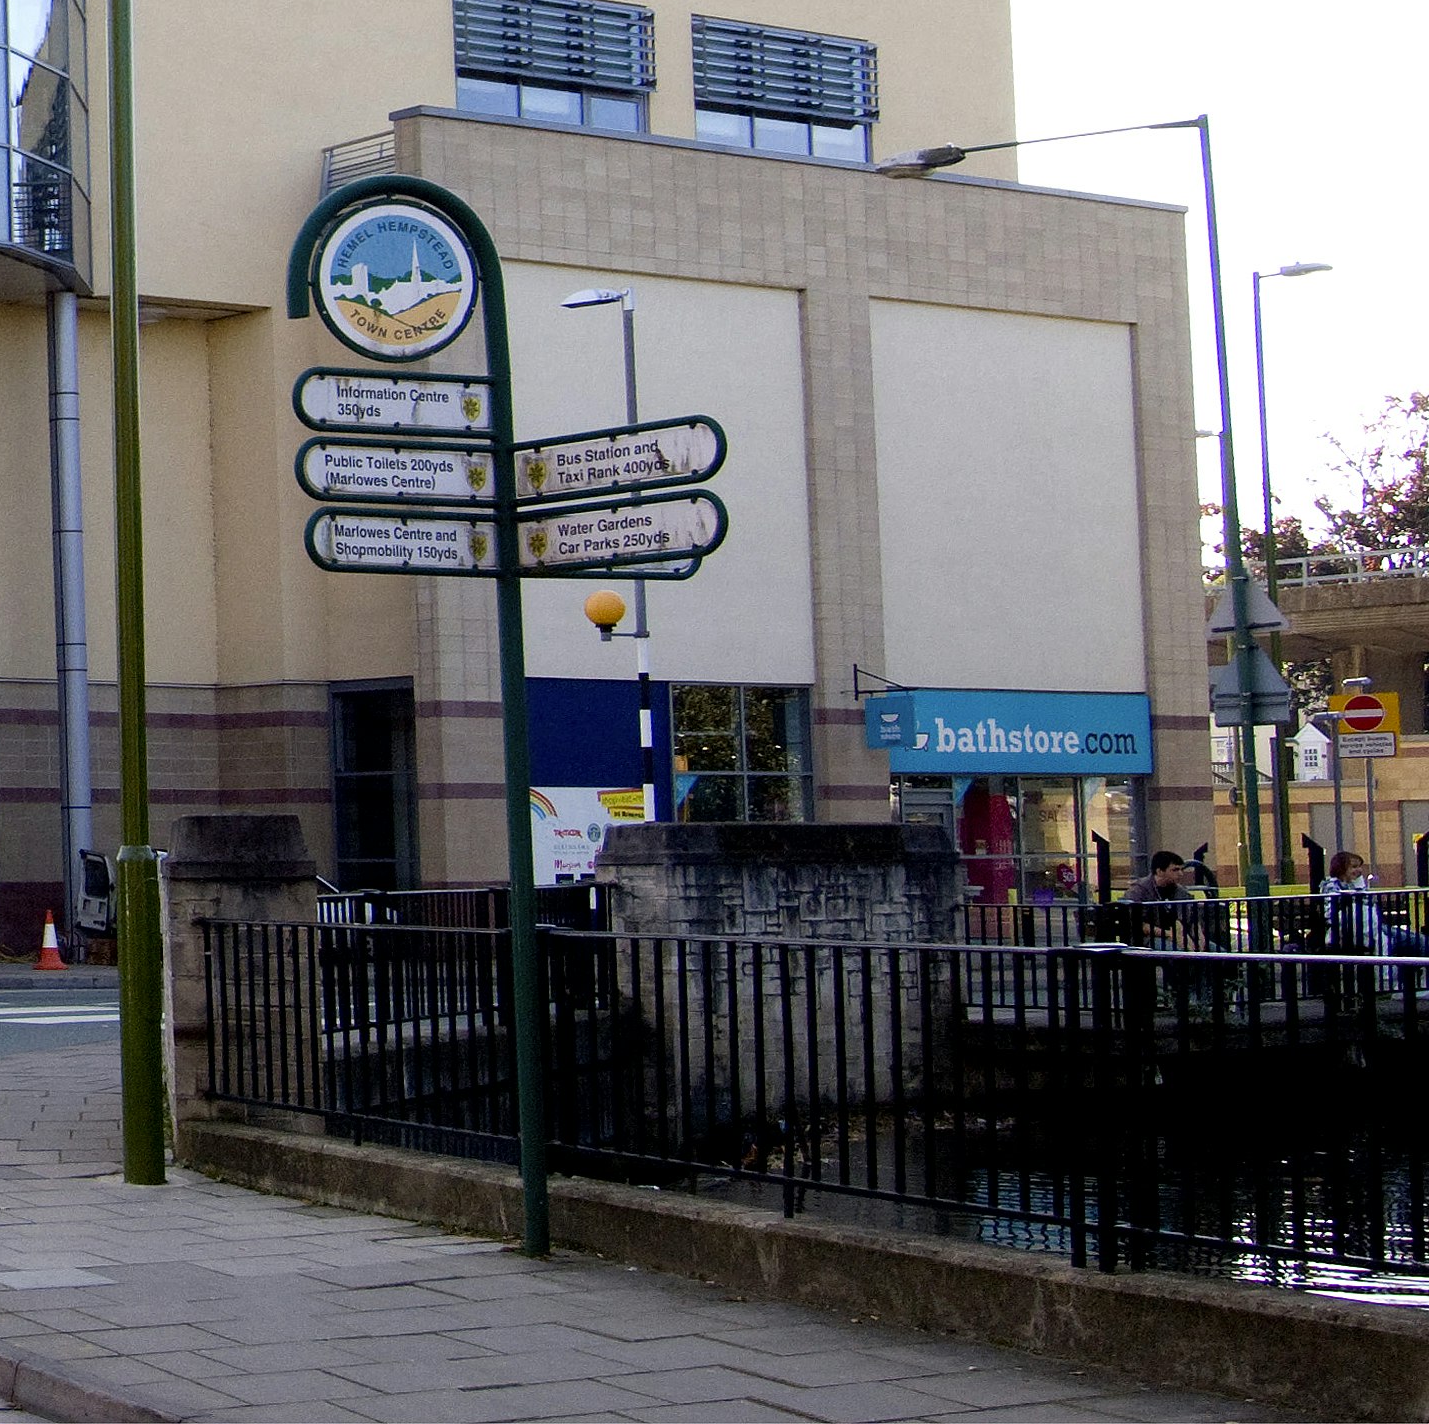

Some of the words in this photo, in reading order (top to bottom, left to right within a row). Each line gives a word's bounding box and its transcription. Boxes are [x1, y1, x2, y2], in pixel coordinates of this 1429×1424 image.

[337, 228, 374, 268] HEMEL
[376, 221, 454, 270] HEMPSTEAD
[349, 308, 388, 339] TOWN
[393, 308, 446, 341] CENTRE
[336, 384, 407, 401] Information
[409, 388, 450, 404] Centre
[337, 403, 382, 420] 350yds
[324, 453, 363, 469] Public
[365, 456, 408, 472] Toilets
[410, 458, 454, 474] 200yds
[556, 453, 582, 467] Bus
[584, 445, 631, 463] Station
[634, 439, 659, 455] and
[324, 470, 389, 488] (Marlowes
[391, 474, 436, 491] Centre)
[557, 469, 584, 485] Taxi
[587, 462, 621, 481] Rank
[623, 457, 671, 476] 400yds
[333, 524, 391, 540] Marlowes
[393, 526, 433, 542] Centre
[435, 529, 458, 543] and
[557, 521, 594, 537] Water
[596, 515, 653, 533] Gardens
[334, 542, 414, 560] Shopmobility
[416, 546, 459, 562] 150yds
[558, 541, 581, 556] Car
[583, 536, 620, 553] Parks
[623, 530, 671, 549] 250yds
[934, 717, 1139, 755] bathstore.com
